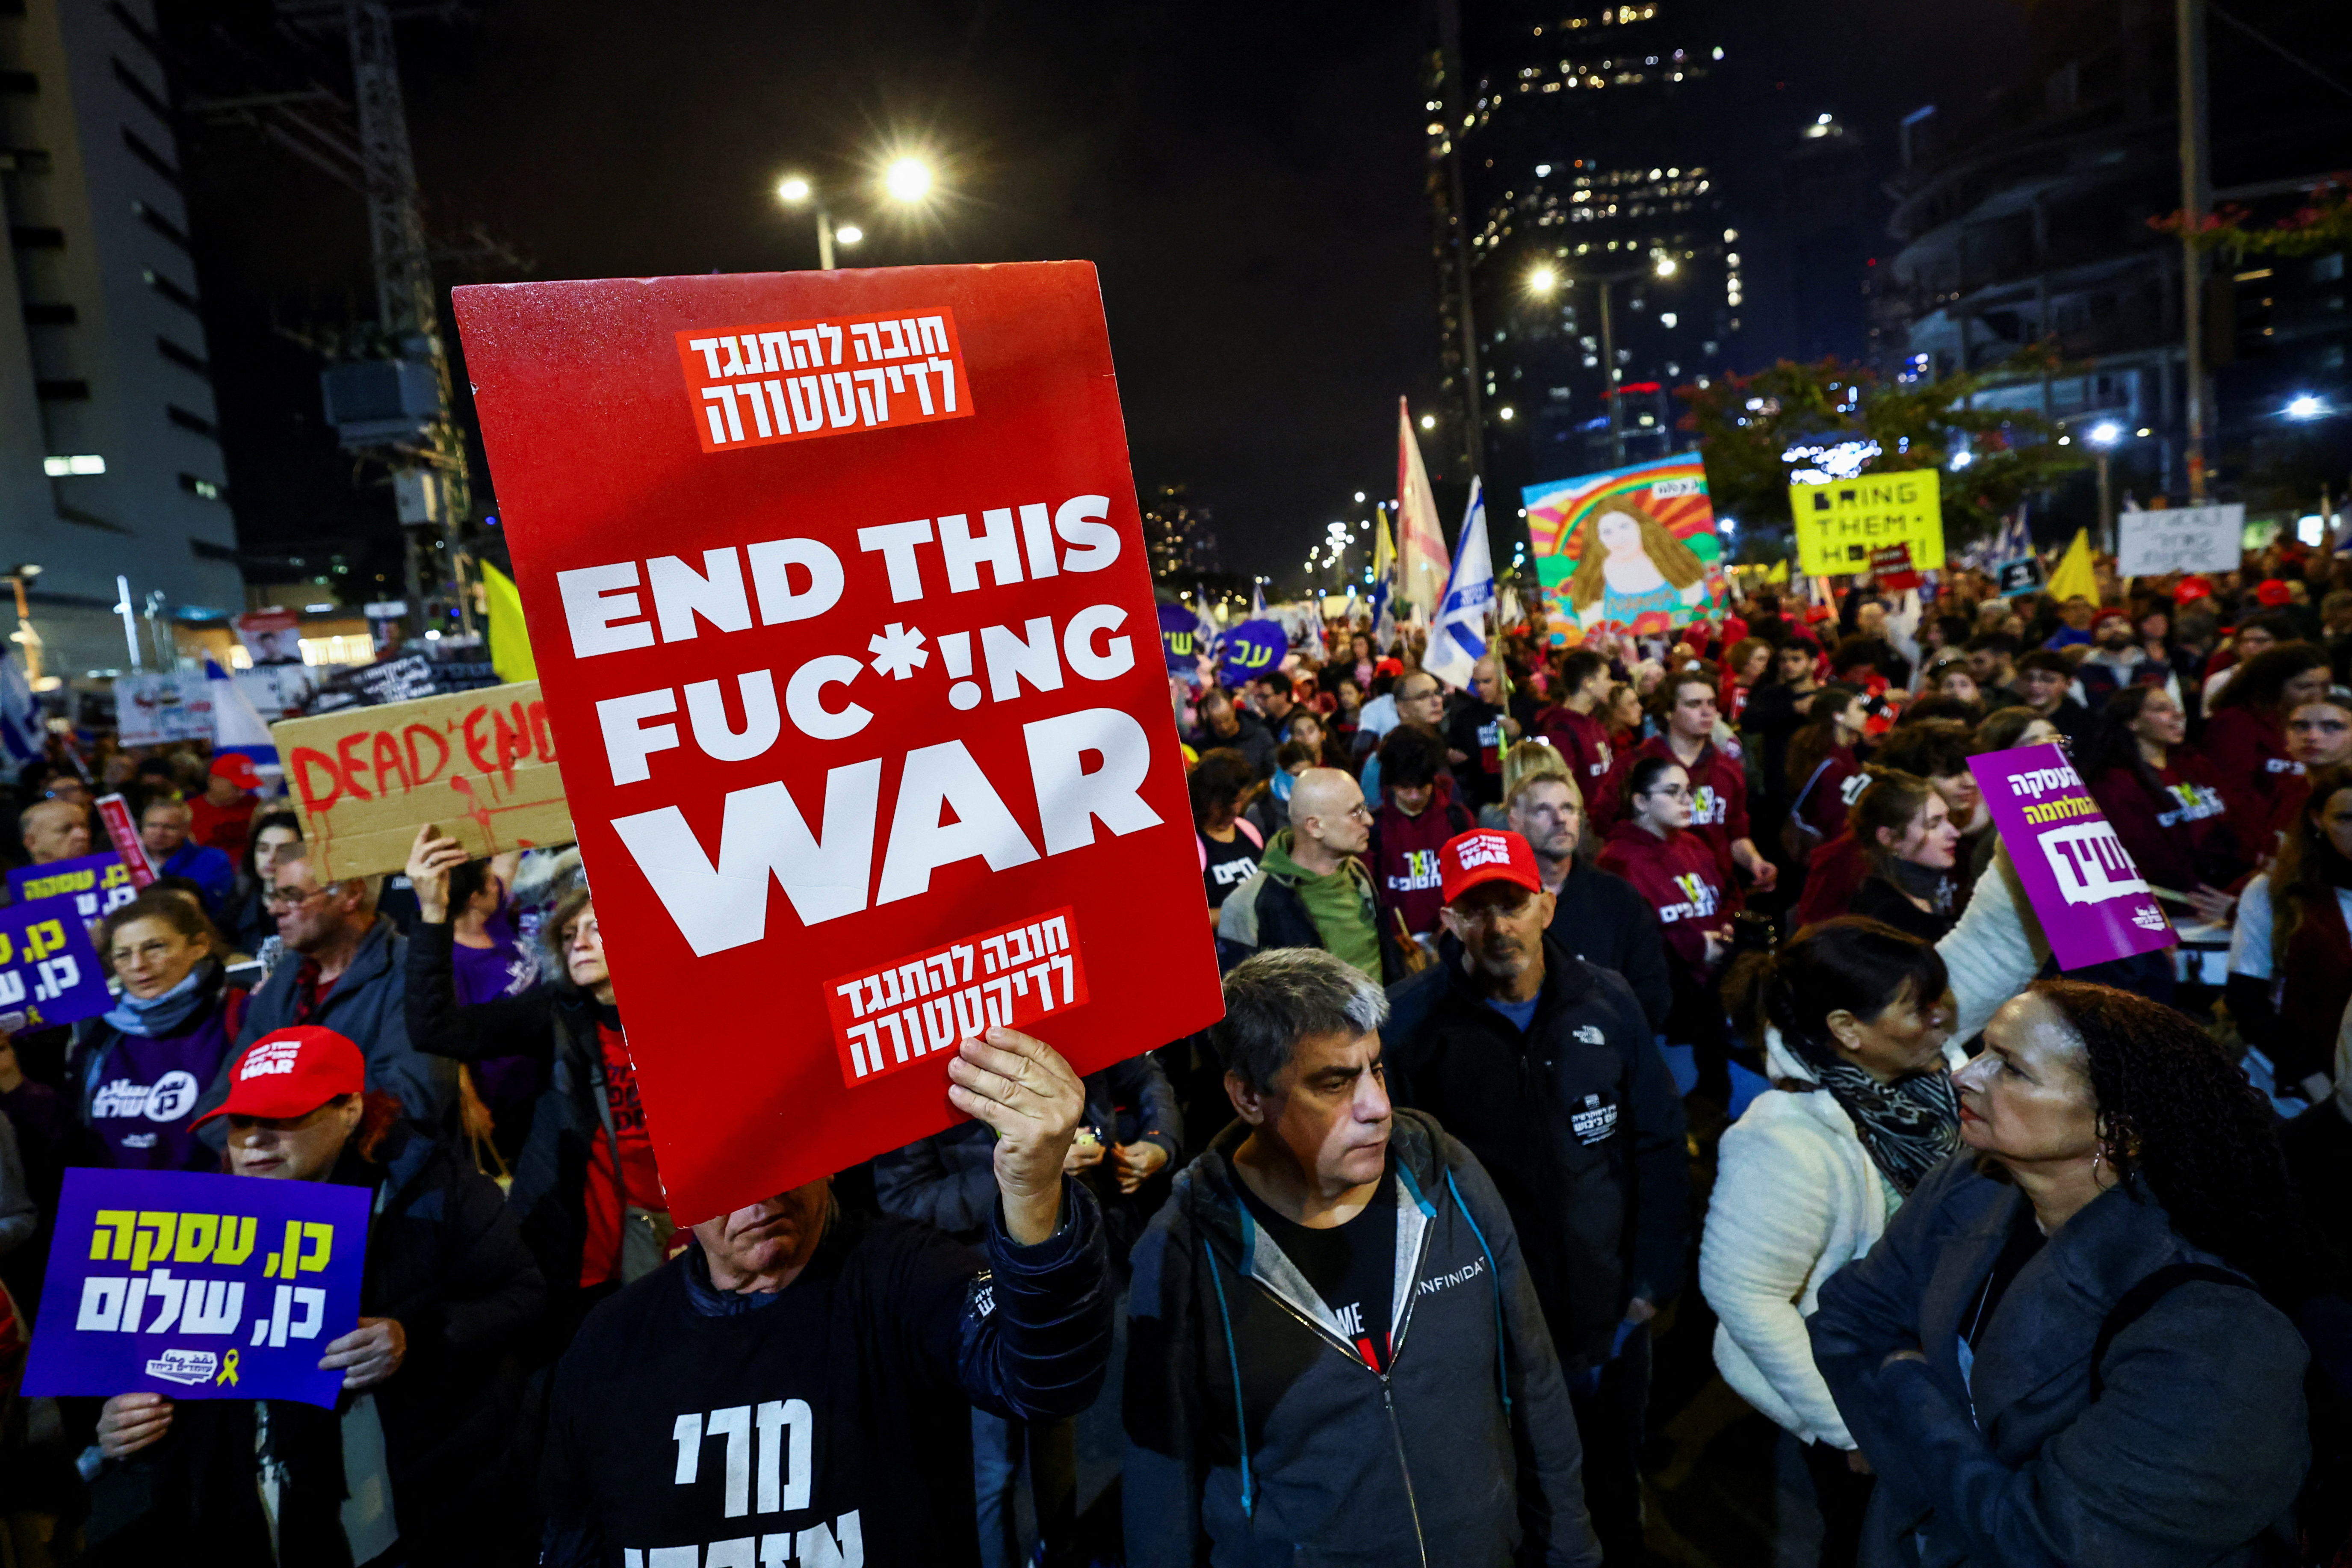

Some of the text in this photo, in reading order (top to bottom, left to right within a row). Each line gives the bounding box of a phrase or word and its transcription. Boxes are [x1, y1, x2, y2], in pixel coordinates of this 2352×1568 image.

[690, 316, 949, 378] חובה להתנגד
[701, 357, 956, 444] לדיקטטורה
[1814, 482, 1917, 511] BRING
[556, 495, 1120, 659] END THIS
[290, 724, 450, 809] DEAD
[610, 708, 1164, 957] WAR
[1460, 850, 1510, 870] WAR
[1479, 834, 1506, 844] THIS
[22, 918, 67, 963] כן,
[837, 915, 1069, 1018] חובה להתנגד
[34, 954, 81, 1002] כן,
[846, 954, 1073, 1078] לדיקטטורה
[240, 1059, 295, 1081] WAR
[90, 1210, 333, 1279] כן, עסקה
[77, 1269, 325, 1347] כן, שלום
[673, 1400, 812, 1517] מרי
